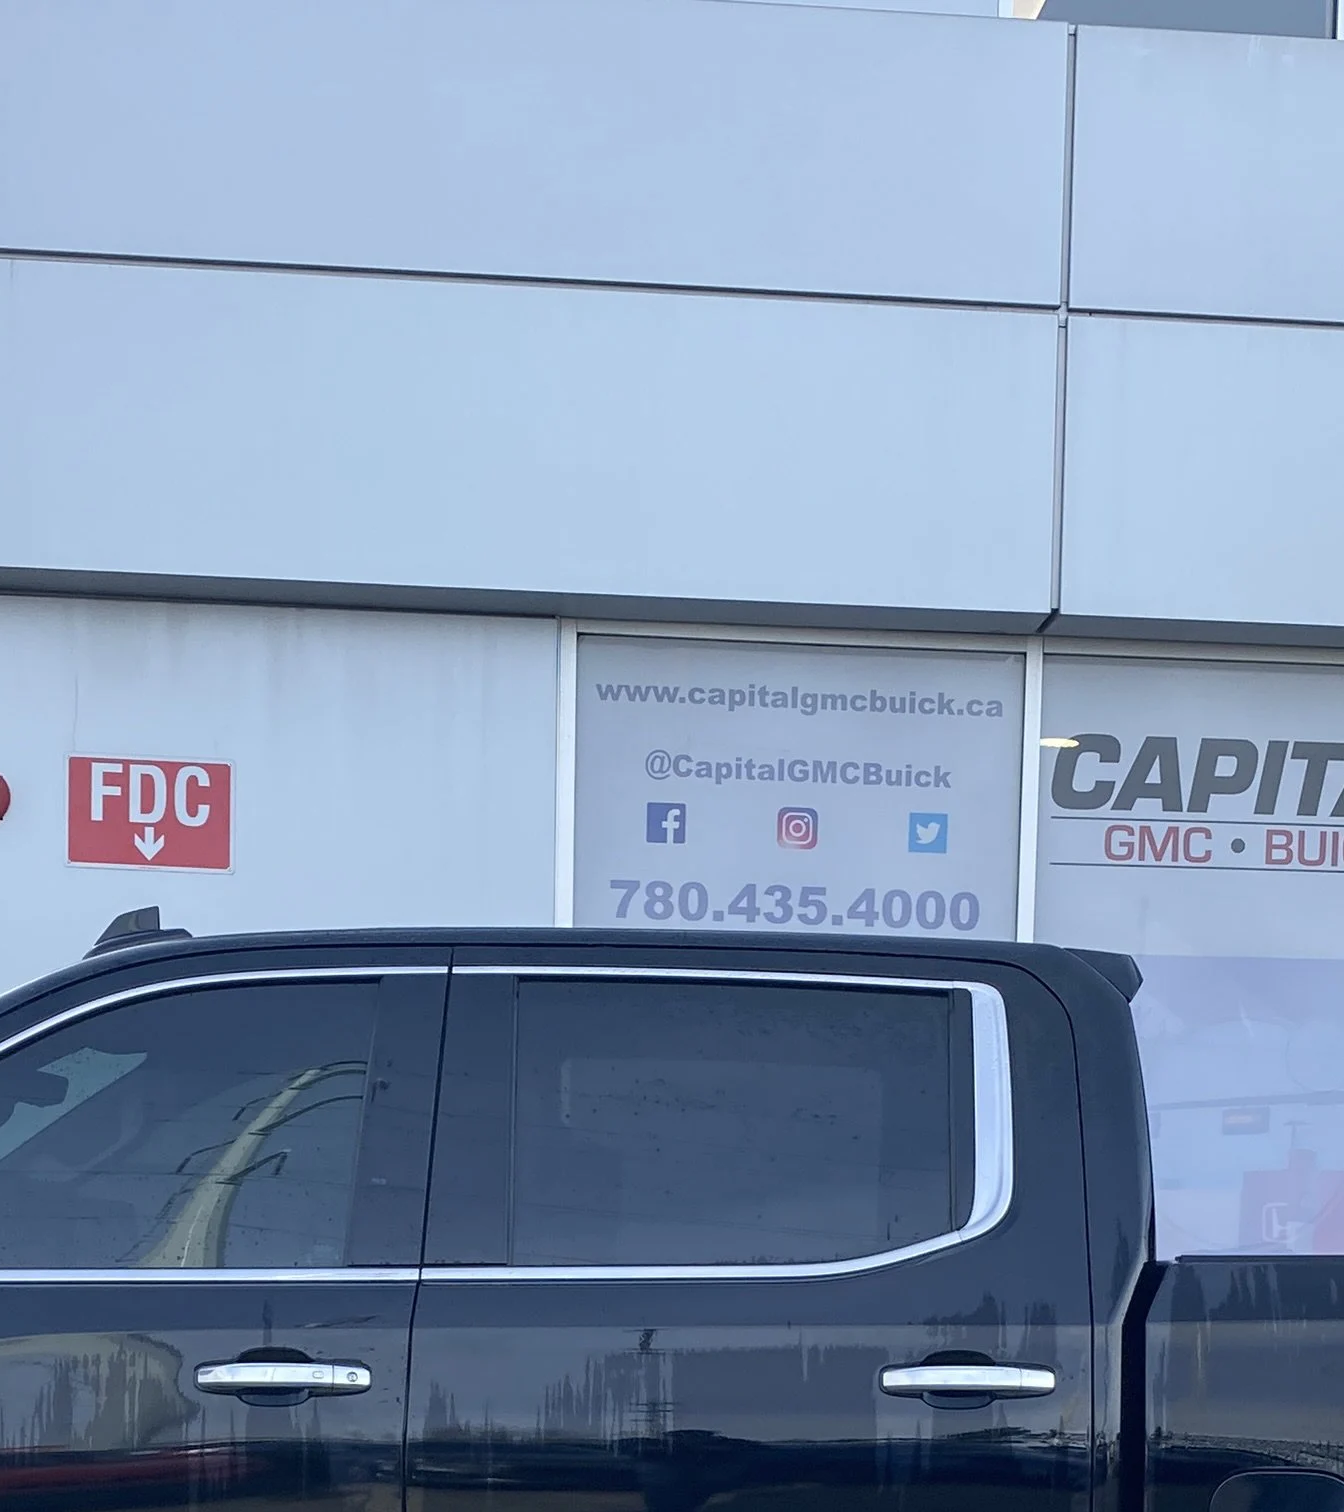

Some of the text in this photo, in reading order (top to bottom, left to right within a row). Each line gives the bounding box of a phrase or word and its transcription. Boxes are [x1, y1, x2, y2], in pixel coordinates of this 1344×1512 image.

[596, 683, 1003, 717] www.capitalgmcbuick.ca
[645, 749, 952, 788] @CapitalGMCBuick
[91, 762, 210, 827] FDC
[1104, 825, 1212, 863] GMC
[609, 879, 980, 931] 780.435.4000
